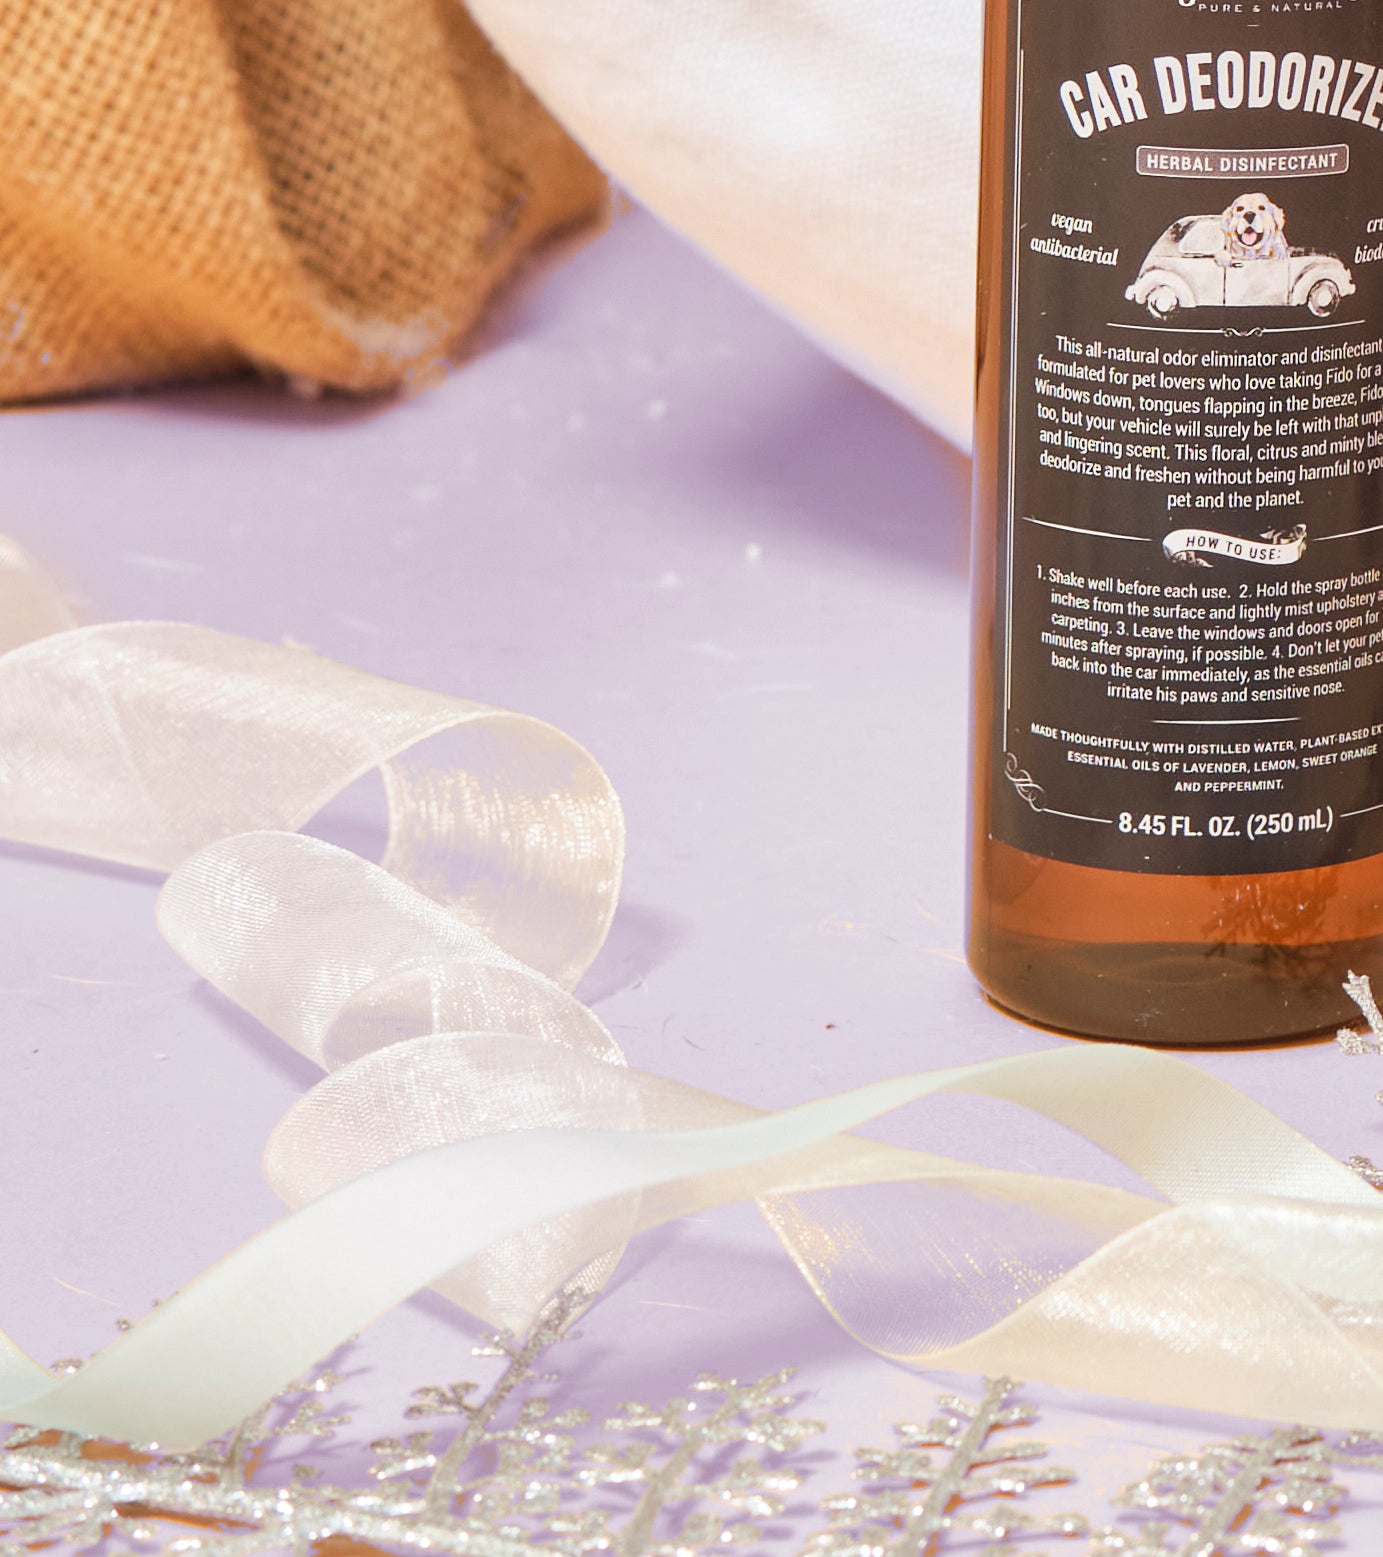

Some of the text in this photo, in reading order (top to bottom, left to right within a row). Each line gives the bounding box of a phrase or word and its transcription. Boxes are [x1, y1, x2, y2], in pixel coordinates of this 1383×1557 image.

[1198, 1, 1342, 13] PURE NATURAL
[1058, 64, 1148, 139] CAR
[1146, 153, 1337, 172] HERBAL DISINFECTANT
[1051, 213, 1093, 235] vegan
[1030, 237, 1119, 265] antibacterial
[1056, 335, 1082, 355] This
[1086, 341, 1158, 364] all-natural
[1163, 350, 1198, 366] odor
[1202, 350, 1278, 367] eliminator
[1281, 347, 1307, 365] and
[1311, 338, 1382, 363] disinfectant
[1038, 354, 1373, 390] formulated for pet lovers who love taking Fido for
[1035, 378, 1090, 404] Windows
[1093, 390, 1135, 412] down,
[1139, 396, 1200, 417] tongues
[1204, 397, 1265, 418] flapping
[1269, 396, 1282, 413] in
[1286, 395, 1309, 411] the
[1312, 392, 1358, 410] breeze,
[1361, 385, 1383, 402] Fido
[1037, 403, 1059, 423] too,
[1062, 407, 1082, 426] but
[1086, 416, 1115, 432] your
[1120, 417, 1171, 436] vehicle
[1175, 421, 1200, 437] will
[1204, 421, 1250, 441] surely
[1254, 422, 1272, 437] be
[1276, 419, 1299, 435] left
[1303, 418, 1331, 434] with
[1334, 413, 1358, 430] that
[1039, 429, 1062, 446] and
[1064, 431, 1122, 460] lingering
[1126, 444, 1170, 460] scent.
[1175, 444, 1207, 462] This
[1212, 445, 1253, 462] floral,
[1257, 444, 1298, 461] citrus
[1301, 440, 1326, 457] and
[1330, 437, 1364, 454] minty
[1040, 449, 1101, 476] deodorize
[1105, 463, 1131, 480] and
[1135, 464, 1191, 484] freshen
[1194, 467, 1251, 484] without
[1256, 467, 1296, 486] being
[1299, 459, 1350, 481] harmful
[1353, 461, 1364, 474] to
[1167, 490, 1304, 511] pet and the planet.
[1186, 536, 1281, 560] HOW TO USE:
[1036, 564, 1380, 599] 1. Shake well before each use. 2. Hold the spray bottle
[1051, 589, 1090, 610] inches
[1093, 596, 1123, 614] from
[1127, 601, 1149, 618] the
[1153, 604, 1206, 619] surface
[1209, 605, 1235, 619] and
[1240, 602, 1282, 622] lightly
[1285, 600, 1313, 617] mist
[1317, 588, 1375, 614] upholstery
[1051, 612, 1112, 637] carpeting.
[1133, 623, 1173, 639] Leave
[1178, 625, 1200, 640] the
[1204, 621, 1265, 640] windows
[1269, 623, 1294, 638] and
[1297, 620, 1333, 636] doors
[1336, 617, 1363, 633] open
[1365, 610, 1380, 626] for
[1041, 629, 1088, 651] minutes
[1091, 639, 1121, 655] after
[1125, 645, 1188, 664] spraying,
[1192, 645, 1202, 661] if
[1288, 640, 1322, 658] Don't
[1325, 639, 1339, 653] let
[1343, 635, 1366, 653] your
[1051, 651, 1080, 670] back
[1083, 657, 1107, 675] into
[1111, 662, 1133, 678] the
[1136, 667, 1158, 679] car
[1162, 666, 1250, 684] immediately,
[1254, 668, 1270, 681] as
[1274, 665, 1296, 679] the
[1299, 655, 1351, 677] essential
[1354, 652, 1373, 669] oils
[1107, 679, 1345, 704] irritate his paws and sensitive nose.
[1031, 723, 1058, 739] MADE
[1152, 742, 1184, 754] WITH
[1188, 743, 1250, 754] DISTILLED
[1300, 727, 1369, 749] PLANT-BASED
[1068, 751, 1128, 770] ESSENTIAL
[1132, 760, 1160, 772] OILS
[1163, 762, 1179, 773] OF
[1182, 762, 1250, 774] LAVENDER,
[1302, 753, 1338, 768] SWEET
[1340, 744, 1378, 761] ORANGE
[1175, 779, 1283, 793] AND PEPPERMINT.
[1118, 806, 1333, 840] 8.45 FL. OZ. (250 mL)
